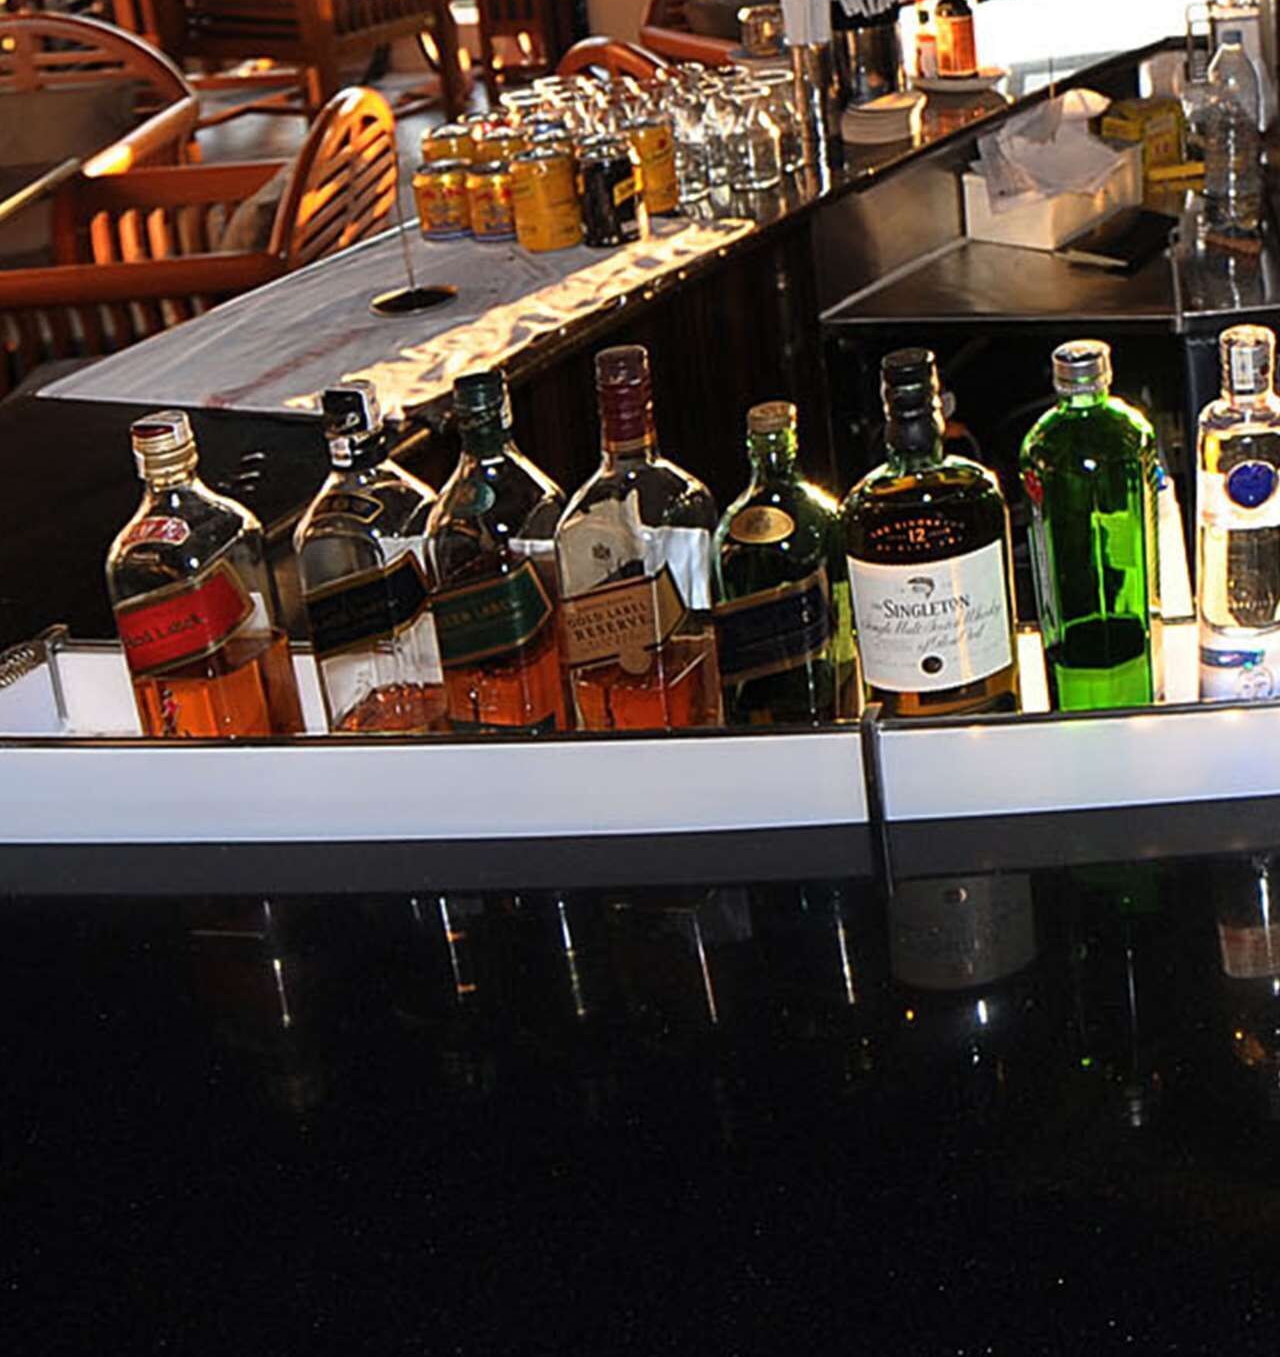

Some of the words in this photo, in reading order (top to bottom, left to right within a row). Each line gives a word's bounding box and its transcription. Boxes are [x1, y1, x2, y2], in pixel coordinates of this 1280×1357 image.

[908, 527, 926, 544] 12
[607, 601, 647, 620] LABEL
[883, 595, 970, 619] SINGLETON
[575, 615, 646, 641] RESERVE
